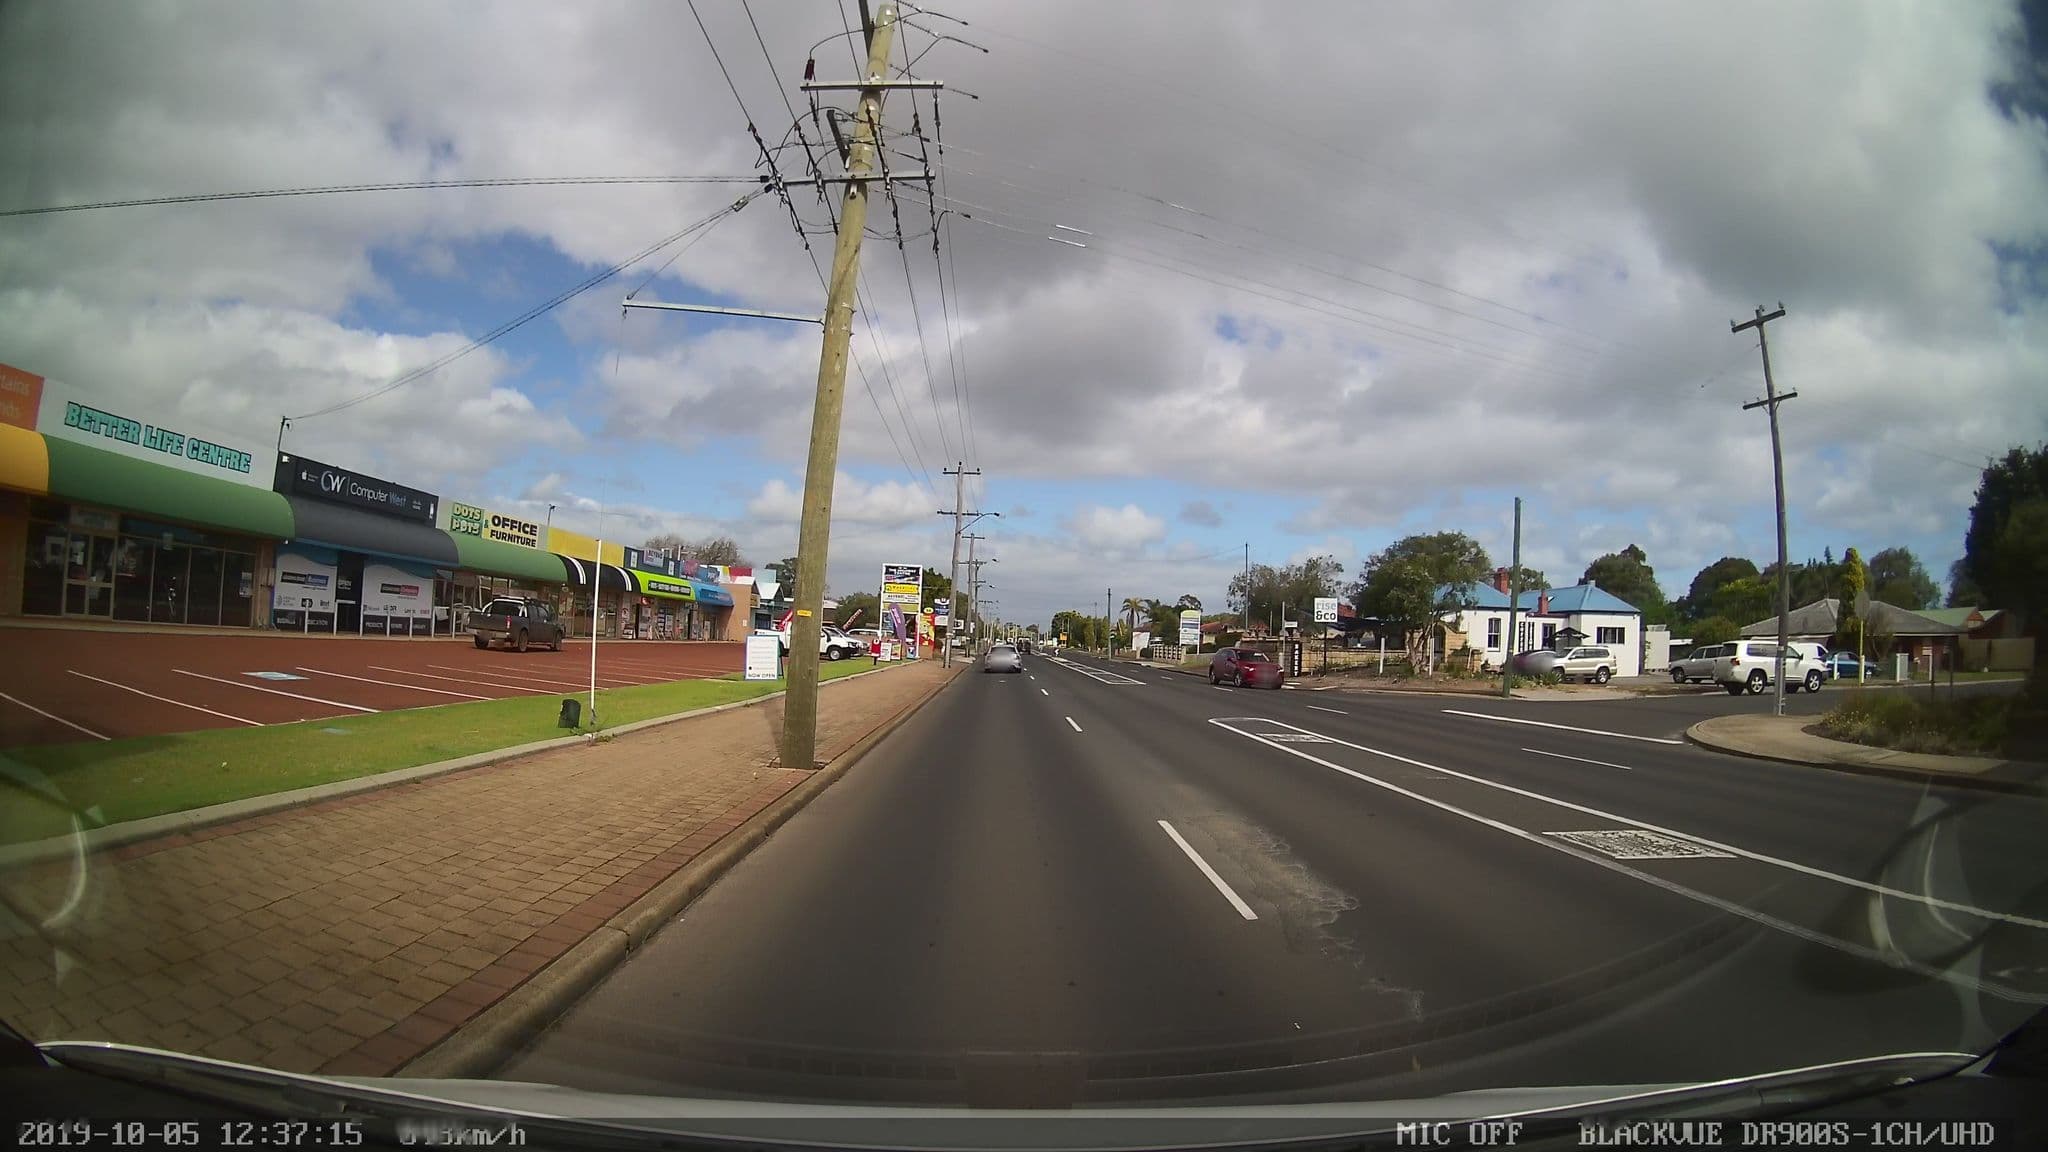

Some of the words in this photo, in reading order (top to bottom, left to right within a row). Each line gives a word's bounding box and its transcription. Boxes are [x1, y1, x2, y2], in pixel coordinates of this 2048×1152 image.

[64, 401, 142, 445] BETTER
[143, 425, 186, 456] LIFE
[186, 437, 252, 473] CENTRE
[321, 470, 346, 493] CW
[350, 482, 388, 502] Computer
[389, 491, 407, 507] West
[491, 514, 538, 537] OFFICE
[489, 528, 537, 548] FURNITURE
[1316, 602, 1337, 610] rise
[1316, 610, 1337, 621] &co
